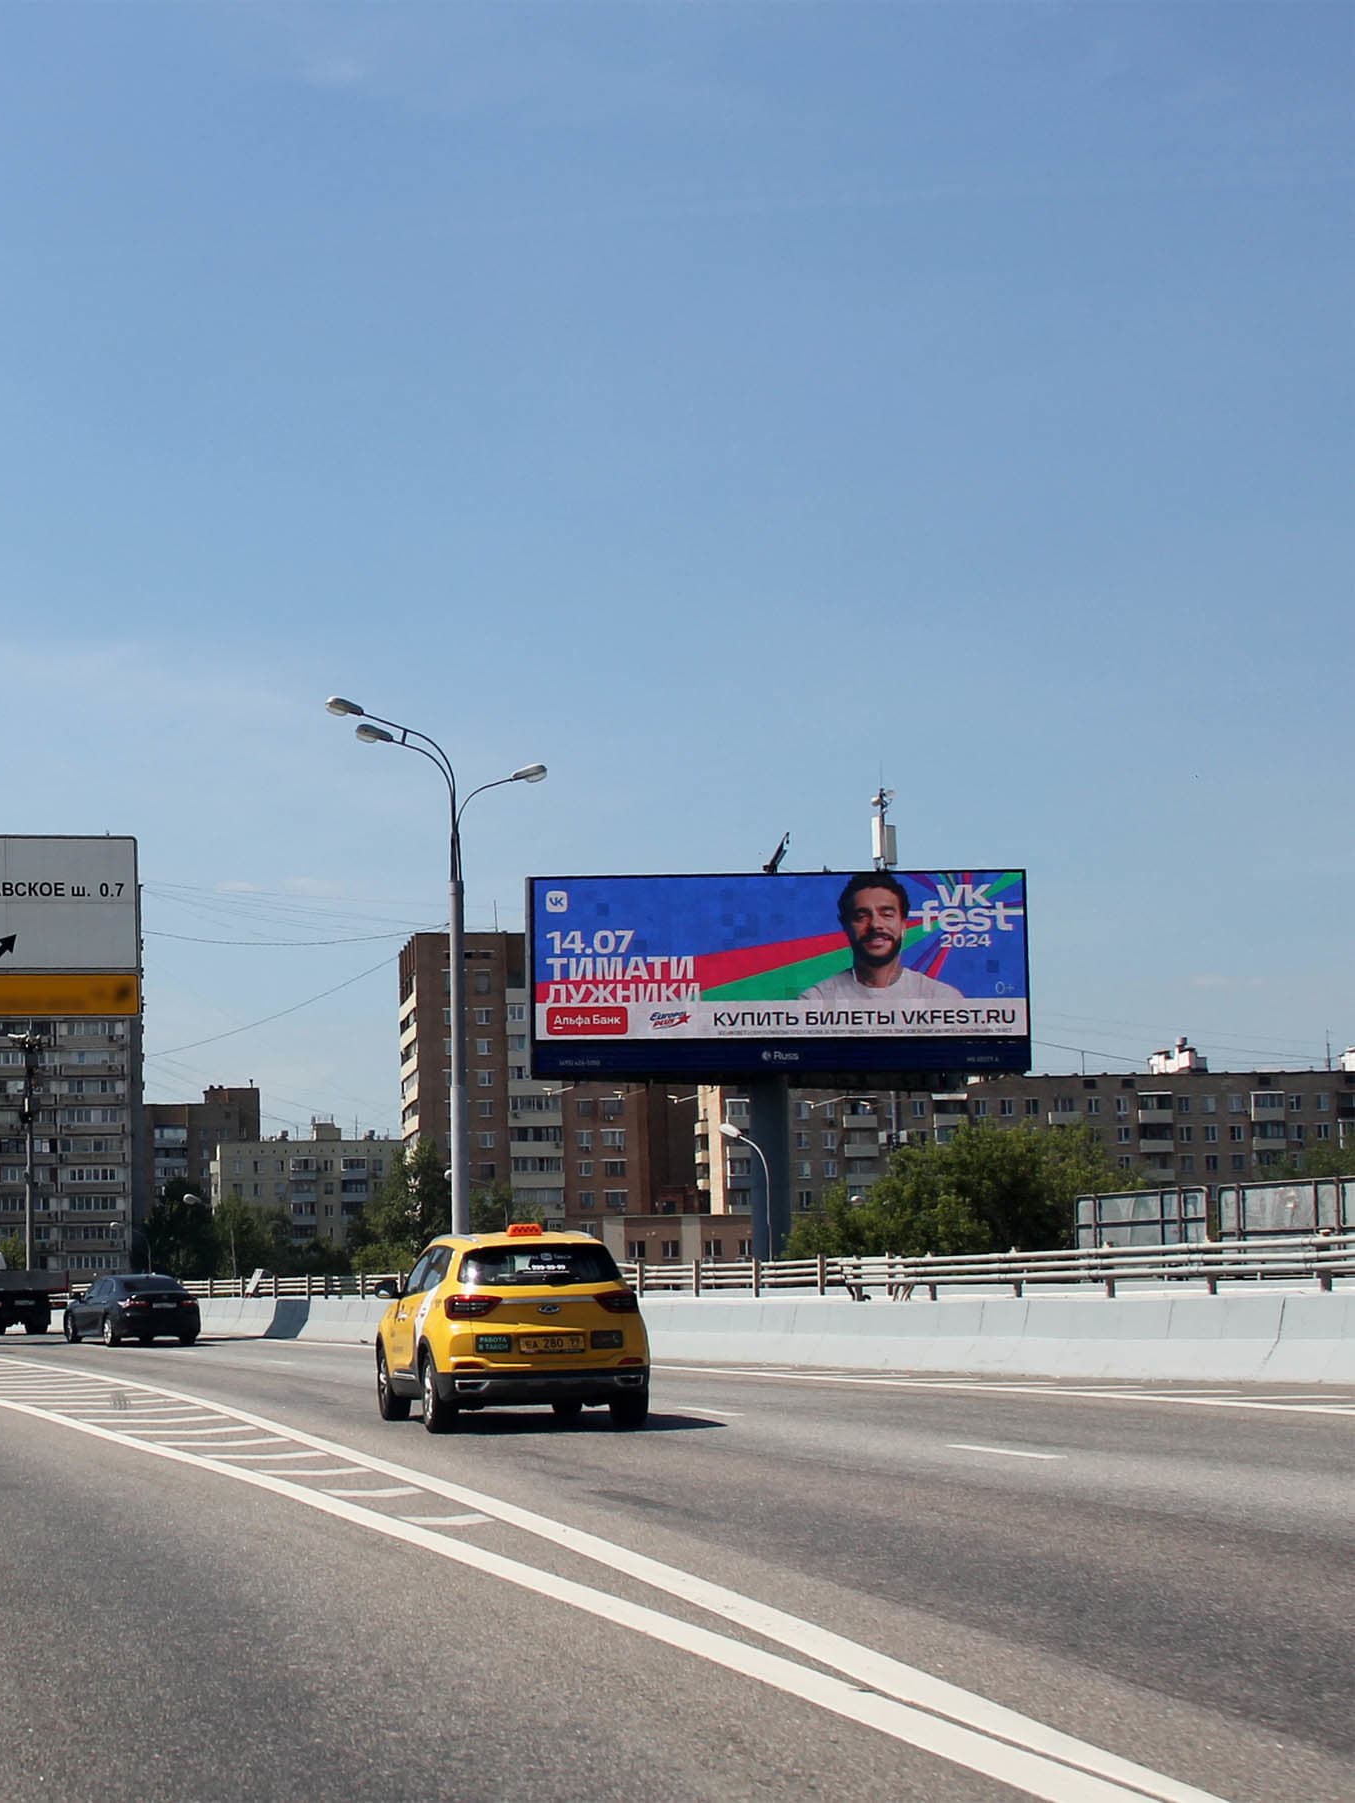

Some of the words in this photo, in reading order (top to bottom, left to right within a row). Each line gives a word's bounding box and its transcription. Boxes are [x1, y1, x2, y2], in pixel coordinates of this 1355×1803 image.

[71, 885, 91, 897] ш.
[99, 883, 125, 897] 0.7
[936, 884, 992, 906] VK
[915, 900, 1019, 932] fest
[546, 930, 635, 954] 14.07
[940, 933, 992, 948] 2024
[546, 956, 694, 981] ТИМАТИ
[546, 983, 700, 1004] ЛУЖНИКИ
[995, 981, 1015, 995] 0+
[553, 1015, 590, 1027] Альфа
[592, 1014, 621, 1025] Банк
[714, 1011, 799, 1026] КУПИТЬ
[805, 1010, 895, 1025] БИЛЕТЫ
[901, 1009, 1016, 1025] VKFEST.RU
[773, 1051, 799, 1061] Russ
